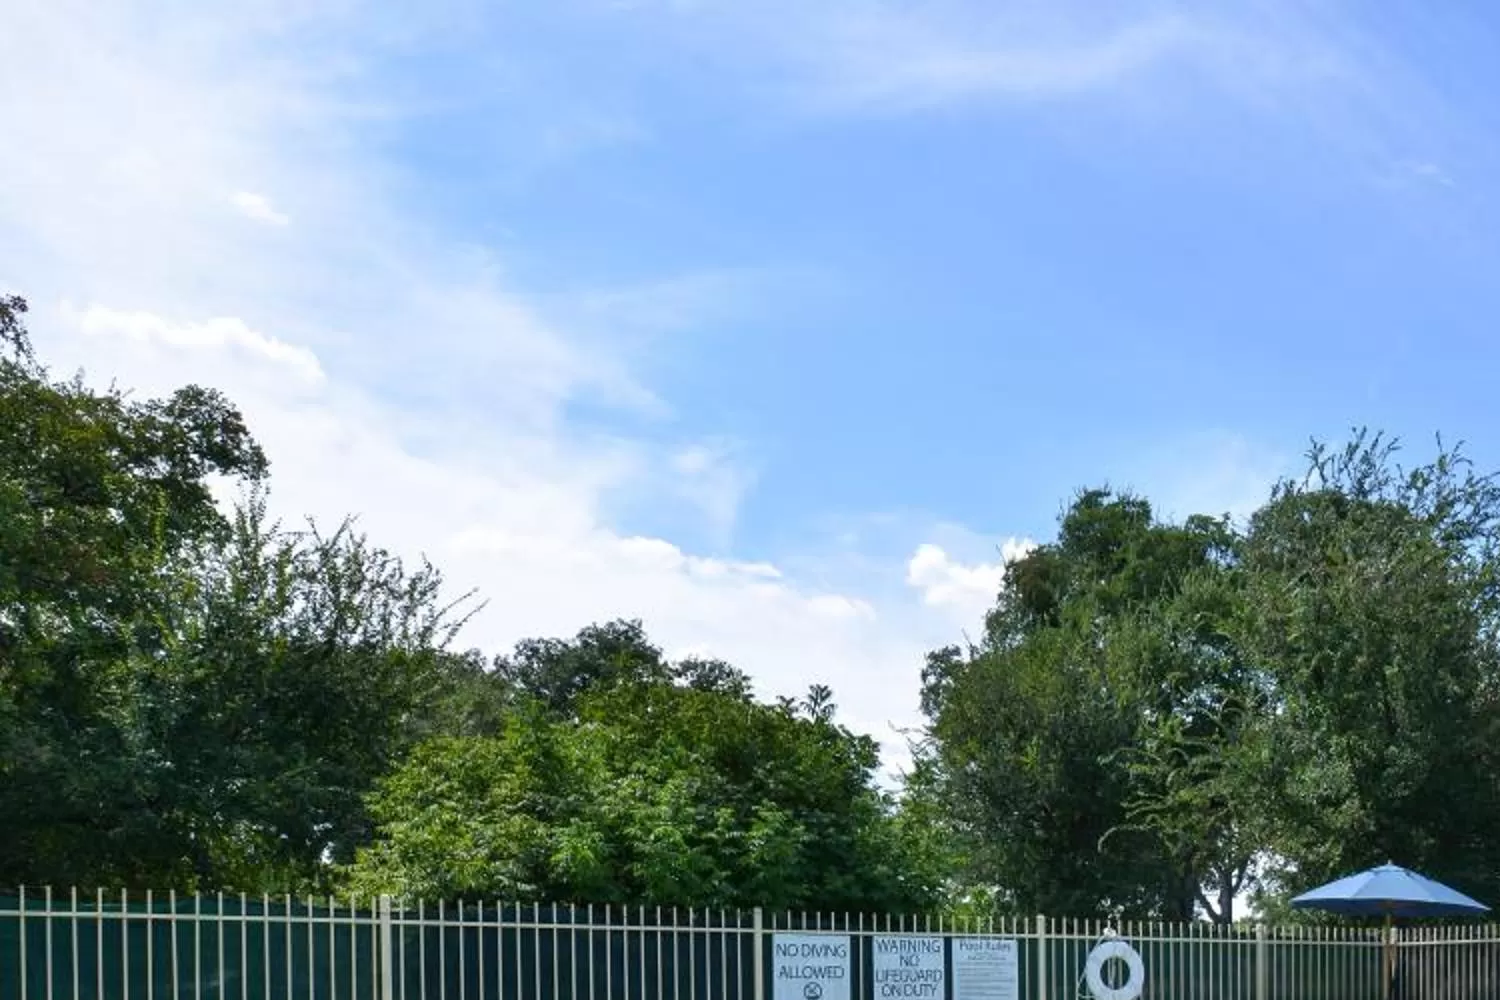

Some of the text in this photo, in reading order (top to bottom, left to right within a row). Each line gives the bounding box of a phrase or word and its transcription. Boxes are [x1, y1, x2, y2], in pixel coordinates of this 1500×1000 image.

[776, 943, 847, 958] NO DIVING
[876, 939, 941, 953] WARNING
[900, 955, 920, 967] NO
[778, 965, 845, 979] ALLOWED
[875, 969, 943, 983] LIFEGUARD
[881, 983, 939, 997] ON DUTY
